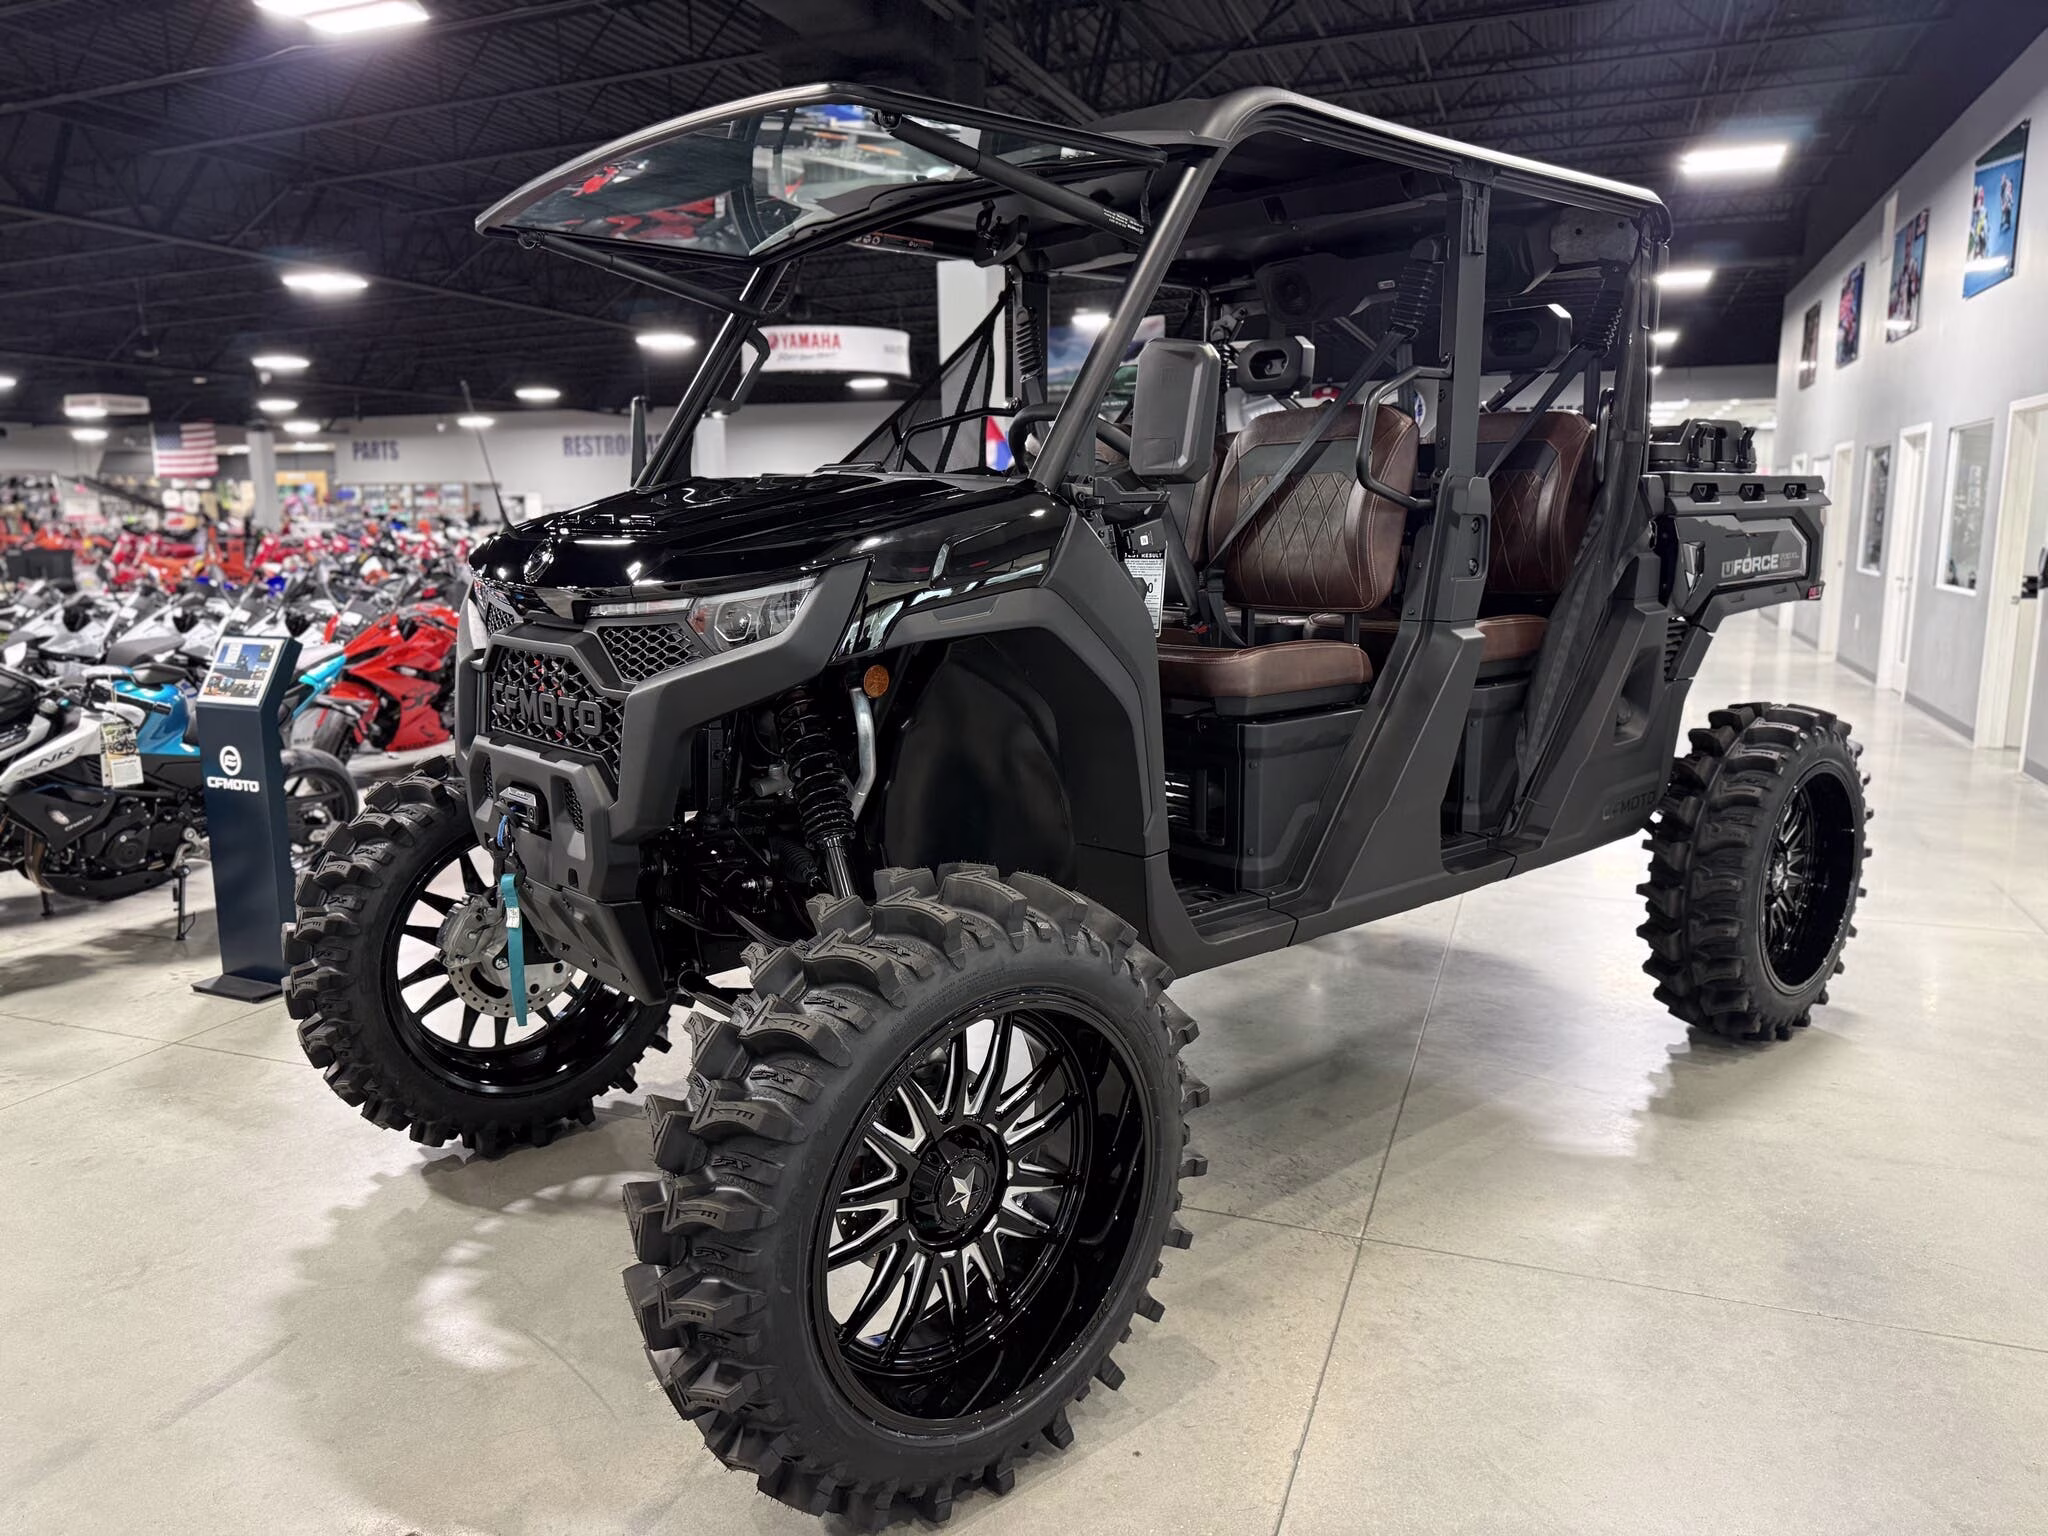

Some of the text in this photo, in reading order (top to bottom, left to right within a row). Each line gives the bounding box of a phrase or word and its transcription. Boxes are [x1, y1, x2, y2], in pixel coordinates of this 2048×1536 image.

[780, 332, 842, 350] YAMAHA
[352, 440, 399, 462] PARTS
[492, 681, 602, 736] CFMOTO
[206, 776, 260, 793] CFMOTO
